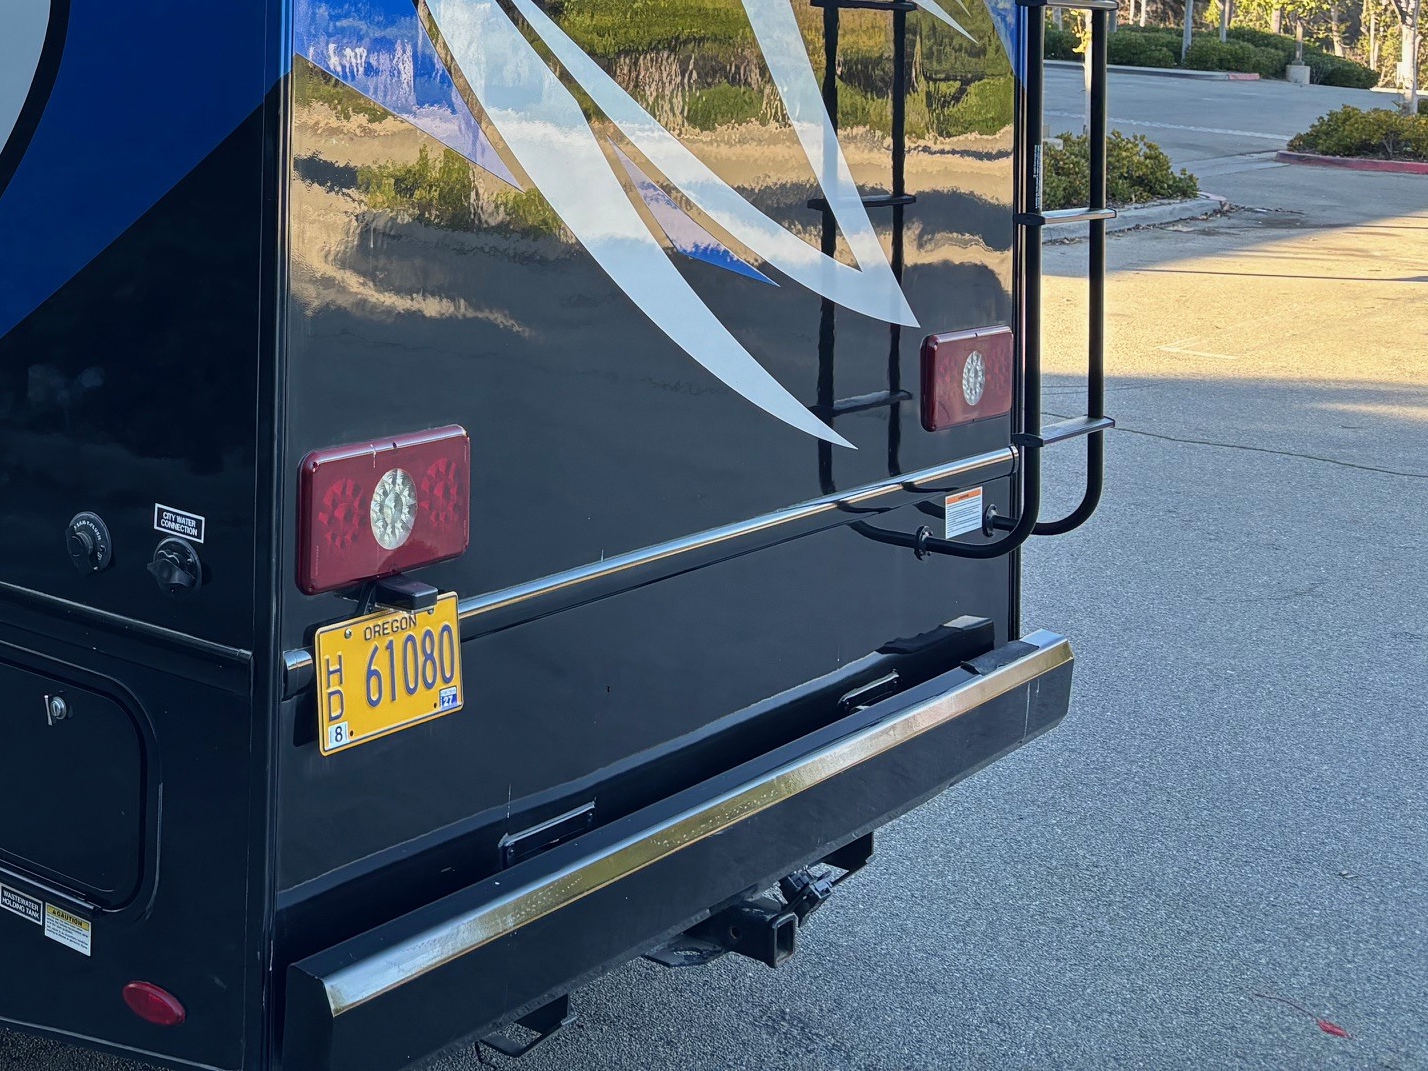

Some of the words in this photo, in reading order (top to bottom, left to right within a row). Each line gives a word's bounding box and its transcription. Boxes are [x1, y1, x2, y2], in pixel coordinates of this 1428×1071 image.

[160, 519, 198, 537] CONNECTION
[162, 511, 176, 521] CITY
[176, 515, 197, 528] WATER
[364, 615, 417, 642] OREGON
[365, 624, 455, 708] 61080
[443, 695, 453, 707] 27
[334, 725, 343, 743] 8
[2, 897, 25, 913] HOLDING
[26, 908, 40, 920] TANK
[3, 890, 39, 912] WASTEWATER
[56, 911, 83, 927] CAUTION
